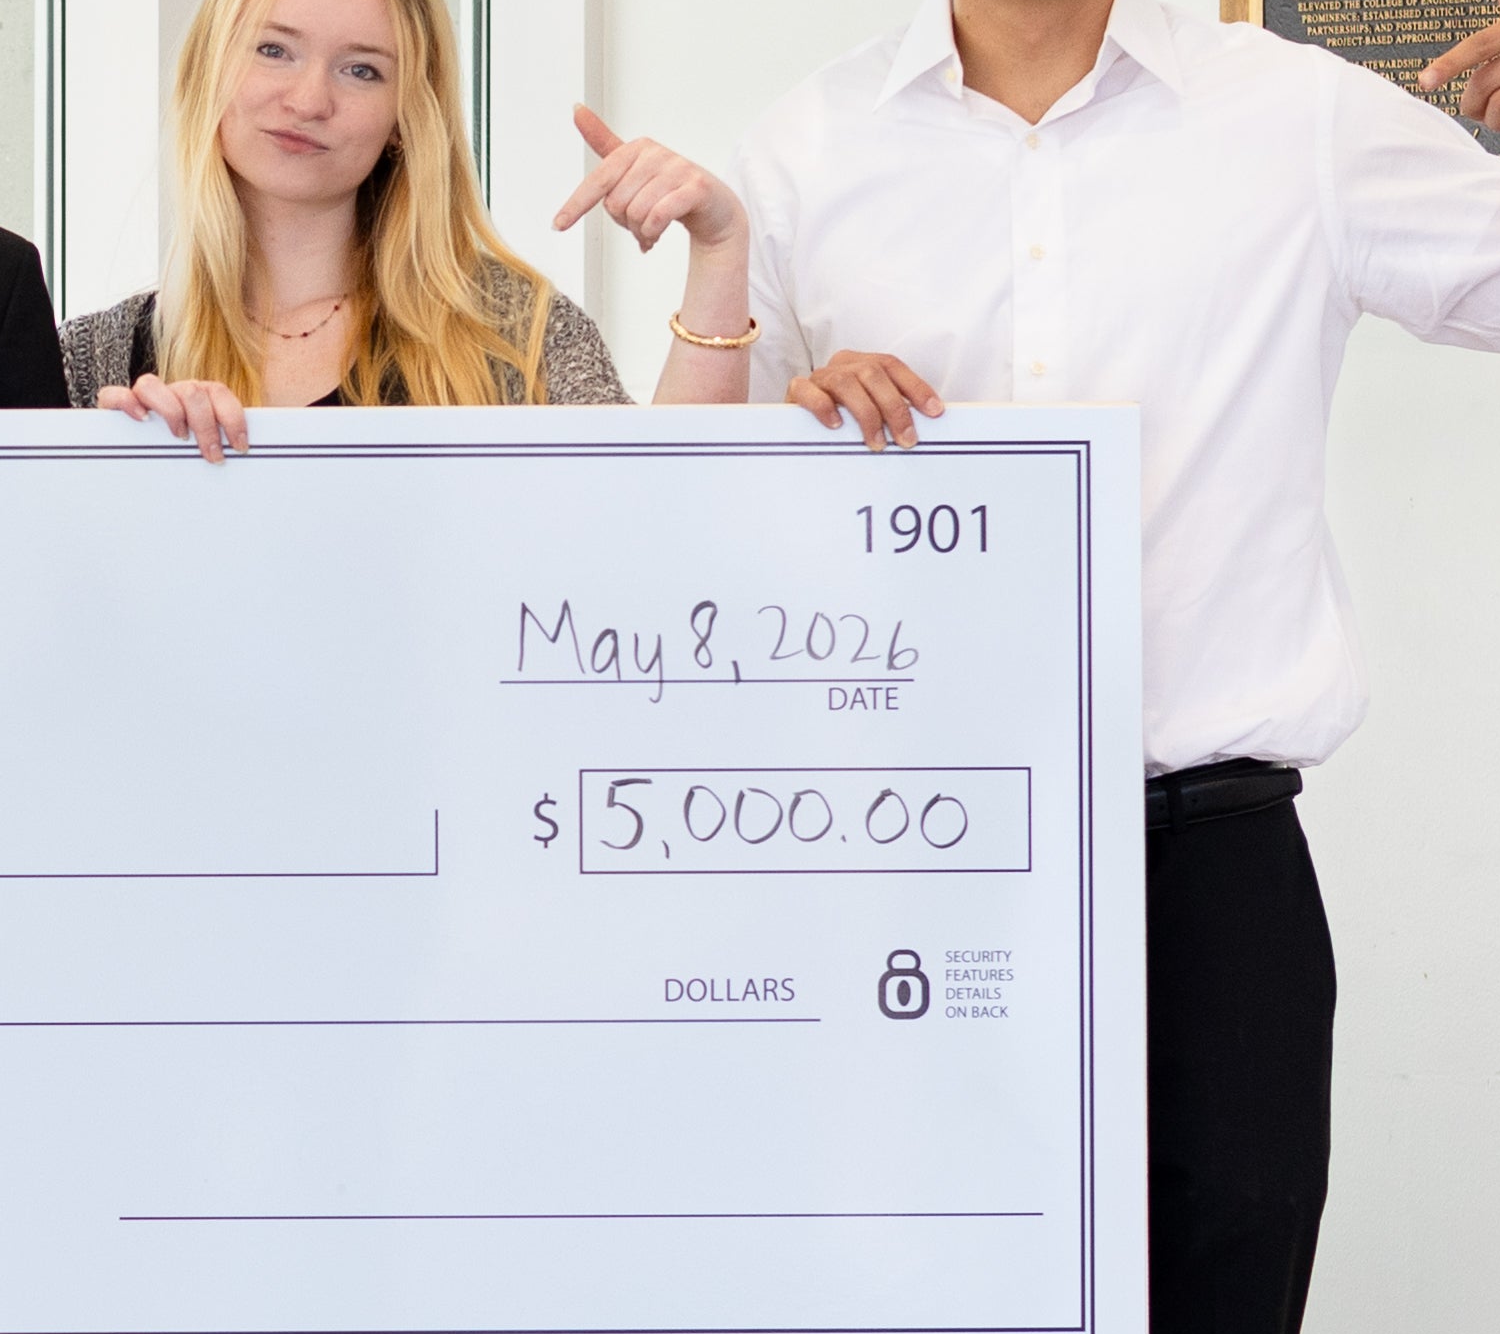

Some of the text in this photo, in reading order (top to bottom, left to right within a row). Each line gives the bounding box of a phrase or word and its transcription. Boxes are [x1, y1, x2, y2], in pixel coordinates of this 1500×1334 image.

[1297, 0, 1341, 12] ELEVATED
[1344, 0, 1360, 9] THE
[1301, 11, 1360, 24] PROMINENCE;
[1362, 8, 1421, 21] ESTABLISHED
[1423, 6, 1465, 18] CRITICAL
[1306, 23, 1371, 37] PARTNERSHIPS;
[1374, 22, 1393, 32] AND
[1395, 19, 1440, 31] FOSTERED
[1326, 31, 1467, 47] PROJECT-BASED APPROACHES TO
[856, 504, 987, 554] 1901
[517, 599, 919, 704] May 8, 2026
[828, 686, 900, 711] DATE
[533, 792, 559, 849] $
[600, 777, 969, 860] 5,000.00
[945, 950, 1012, 964] SECURITY
[945, 968, 1015, 982] FEATURES
[664, 977, 796, 1003] DOLLARS
[945, 987, 1002, 1001] DETAILS
[945, 1005, 1009, 1019] ON BACK
